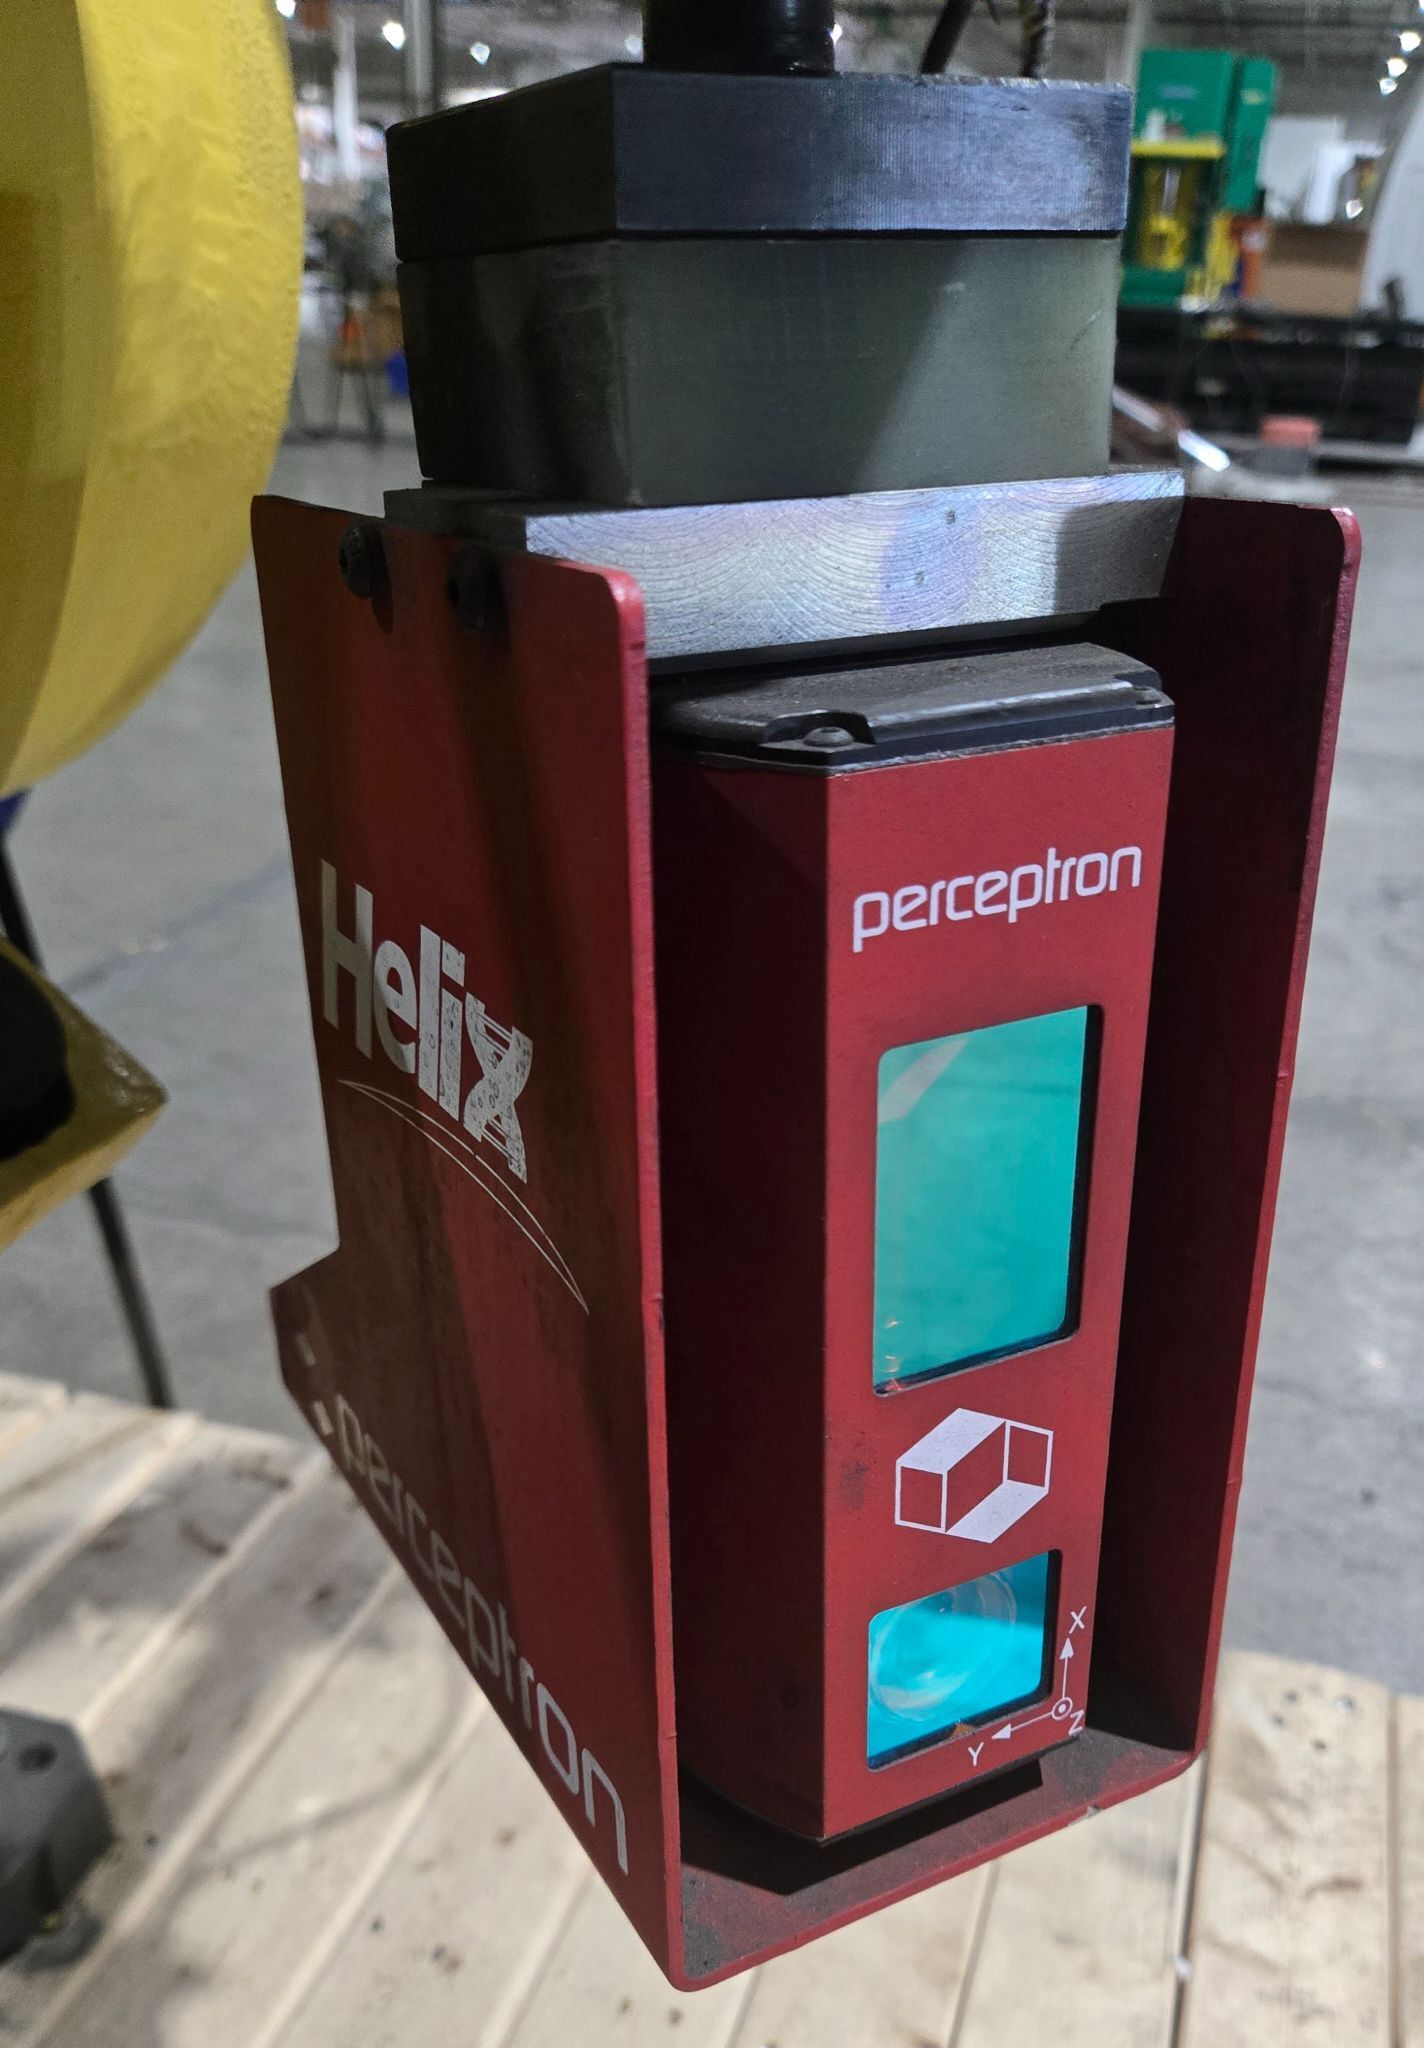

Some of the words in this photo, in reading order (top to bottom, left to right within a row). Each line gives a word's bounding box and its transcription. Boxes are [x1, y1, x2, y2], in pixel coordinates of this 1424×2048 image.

[853, 846, 1142, 953] perceptron
[321, 859, 533, 1184] Helix
[336, 1393, 628, 1875] perceptron
[1068, 1605, 1087, 1634] X
[967, 1741, 985, 1766] Y
[1068, 1709, 1085, 1736] Z
